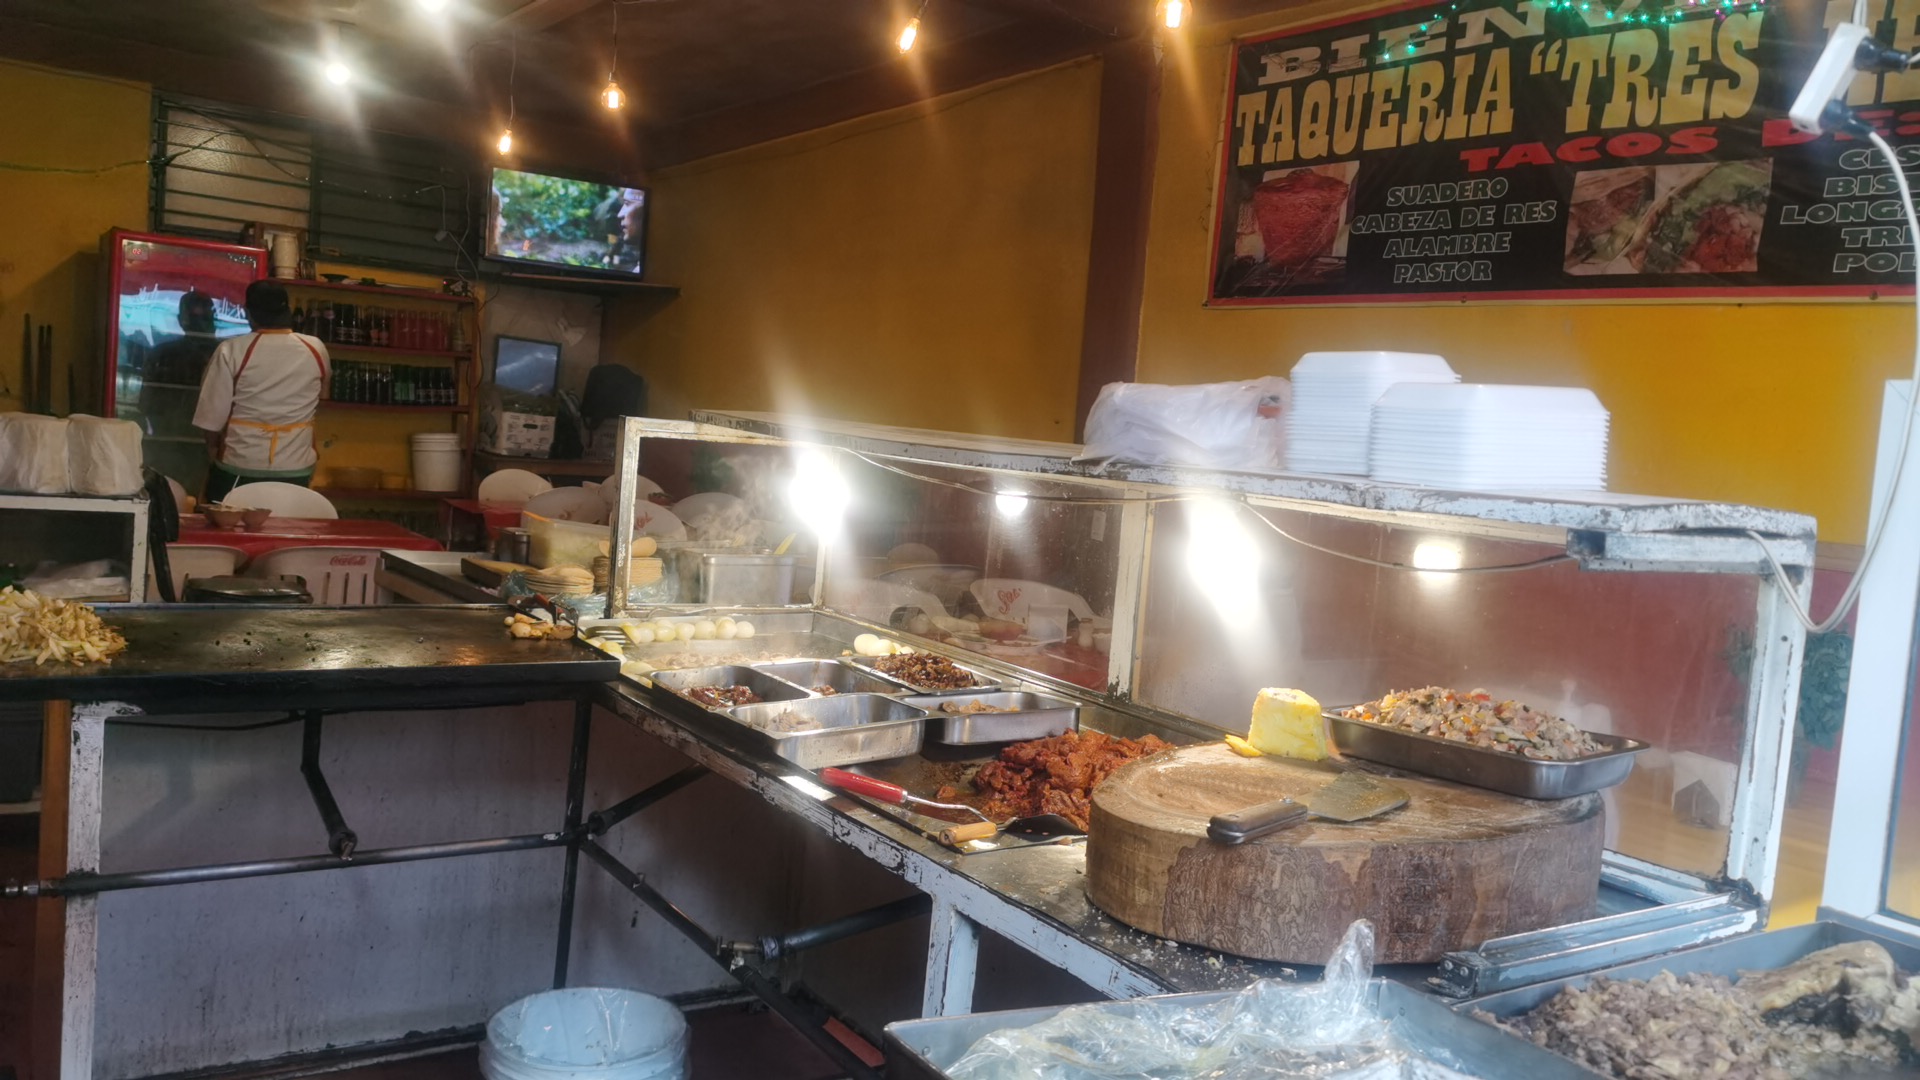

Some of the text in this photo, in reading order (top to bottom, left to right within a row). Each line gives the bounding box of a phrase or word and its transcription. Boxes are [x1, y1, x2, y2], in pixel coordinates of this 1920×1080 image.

[1235, 47, 1514, 167] TAQUERIA
[1459, 126, 1718, 173] TACOS
[1386, 176, 1509, 207] SUADERO
[1350, 200, 1558, 235] CABEZA DE RES
[1382, 231, 1513, 259] ALAMBRE
[1393, 260, 1493, 284] PASTOR
